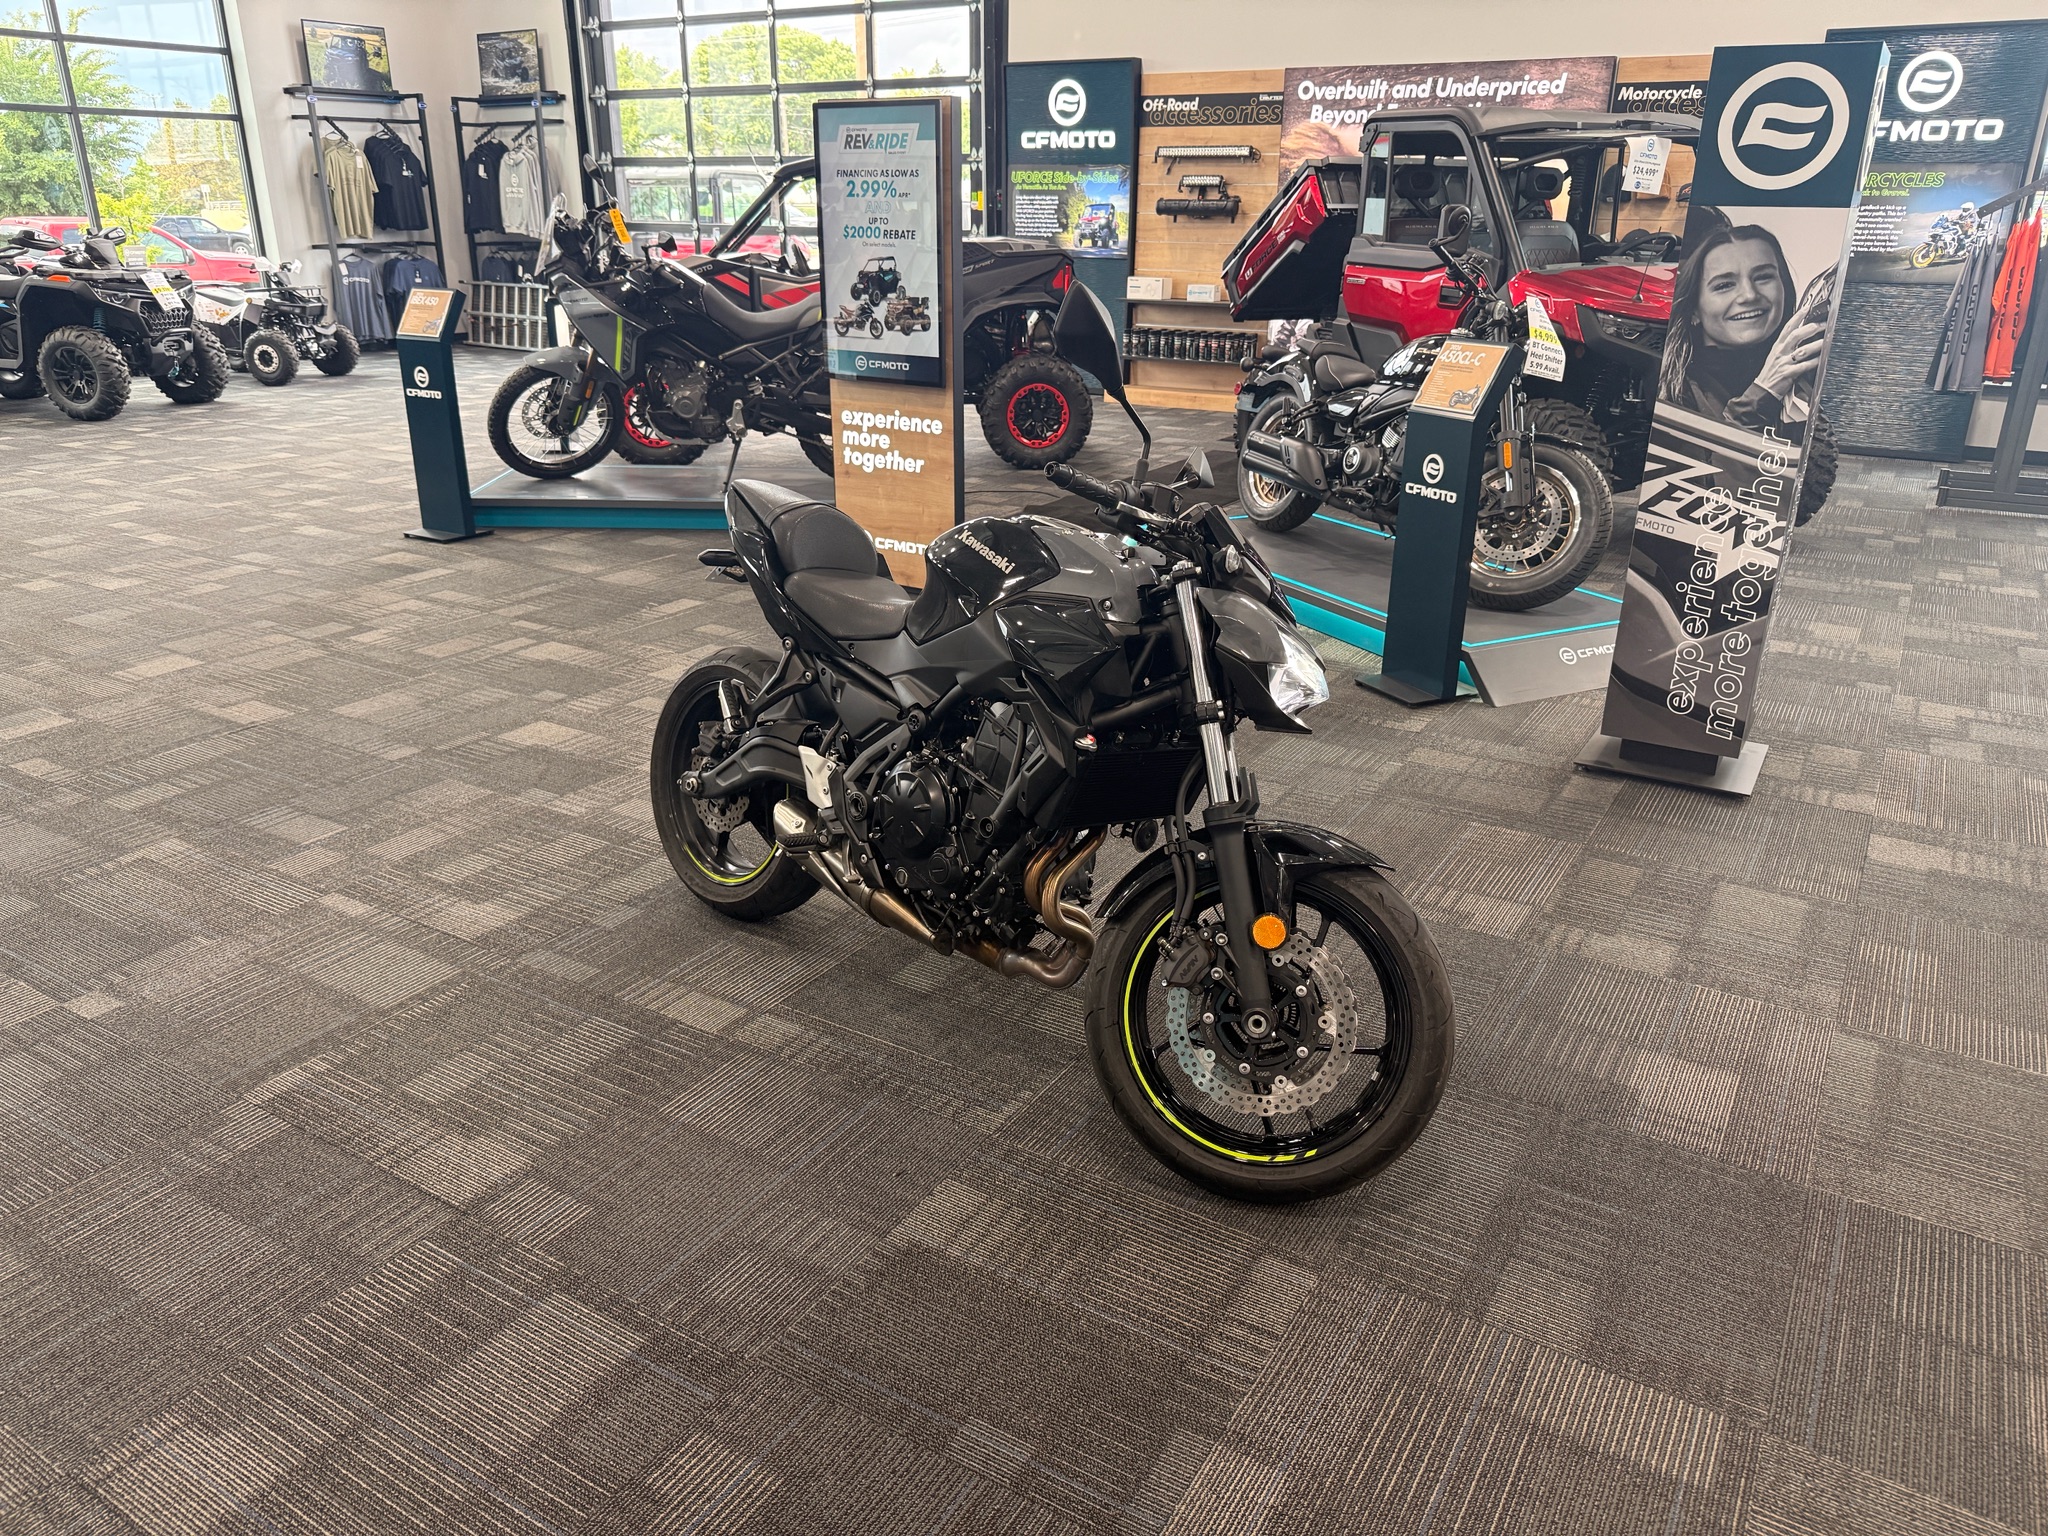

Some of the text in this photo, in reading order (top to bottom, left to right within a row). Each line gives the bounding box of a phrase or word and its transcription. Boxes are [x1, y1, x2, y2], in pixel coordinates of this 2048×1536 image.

[1297, 73, 1568, 102] Overbuilt and Underpriced
[1618, 84, 1703, 104] Motorcycle
[1143, 96, 1199, 112] Off-Road
[1150, 97, 1282, 125] accessories
[1627, 96, 1706, 119] acces
[1021, 130, 1116, 149] CFMOTO
[1875, 119, 2004, 142] FMOTO
[836, 169, 920, 178] FINANCING AS LOW AS
[1011, 171, 1119, 186] UFORCE Side-by-Sides
[1866, 172, 1946, 188] RCYCLES
[846, 180, 897, 198] 2.99%
[865, 201, 892, 214] AND
[868, 217, 889, 225] UP TO
[843, 224, 916, 240] $2000 REBATE
[1439, 350, 1486, 366] 450CL-C
[1530, 351, 1563, 365] Heel Shifter
[1541, 344, 1563, 356] Connect
[869, 360, 910, 371] CFMOTO
[1530, 361, 1560, 374] 5.99 Avail.
[406, 388, 441, 399] CFMOTO
[841, 409, 943, 435] experience
[842, 430, 891, 449] more
[843, 447, 925, 473] together
[1405, 482, 1457, 504] CFMOTO
[1636, 518, 1675, 535] FMOTO
[875, 537, 928, 555] CFMOT
[958, 529, 1016, 575] Kawasaki
[1706, 426, 1791, 741] more together
[1667, 486, 1732, 715] experience
